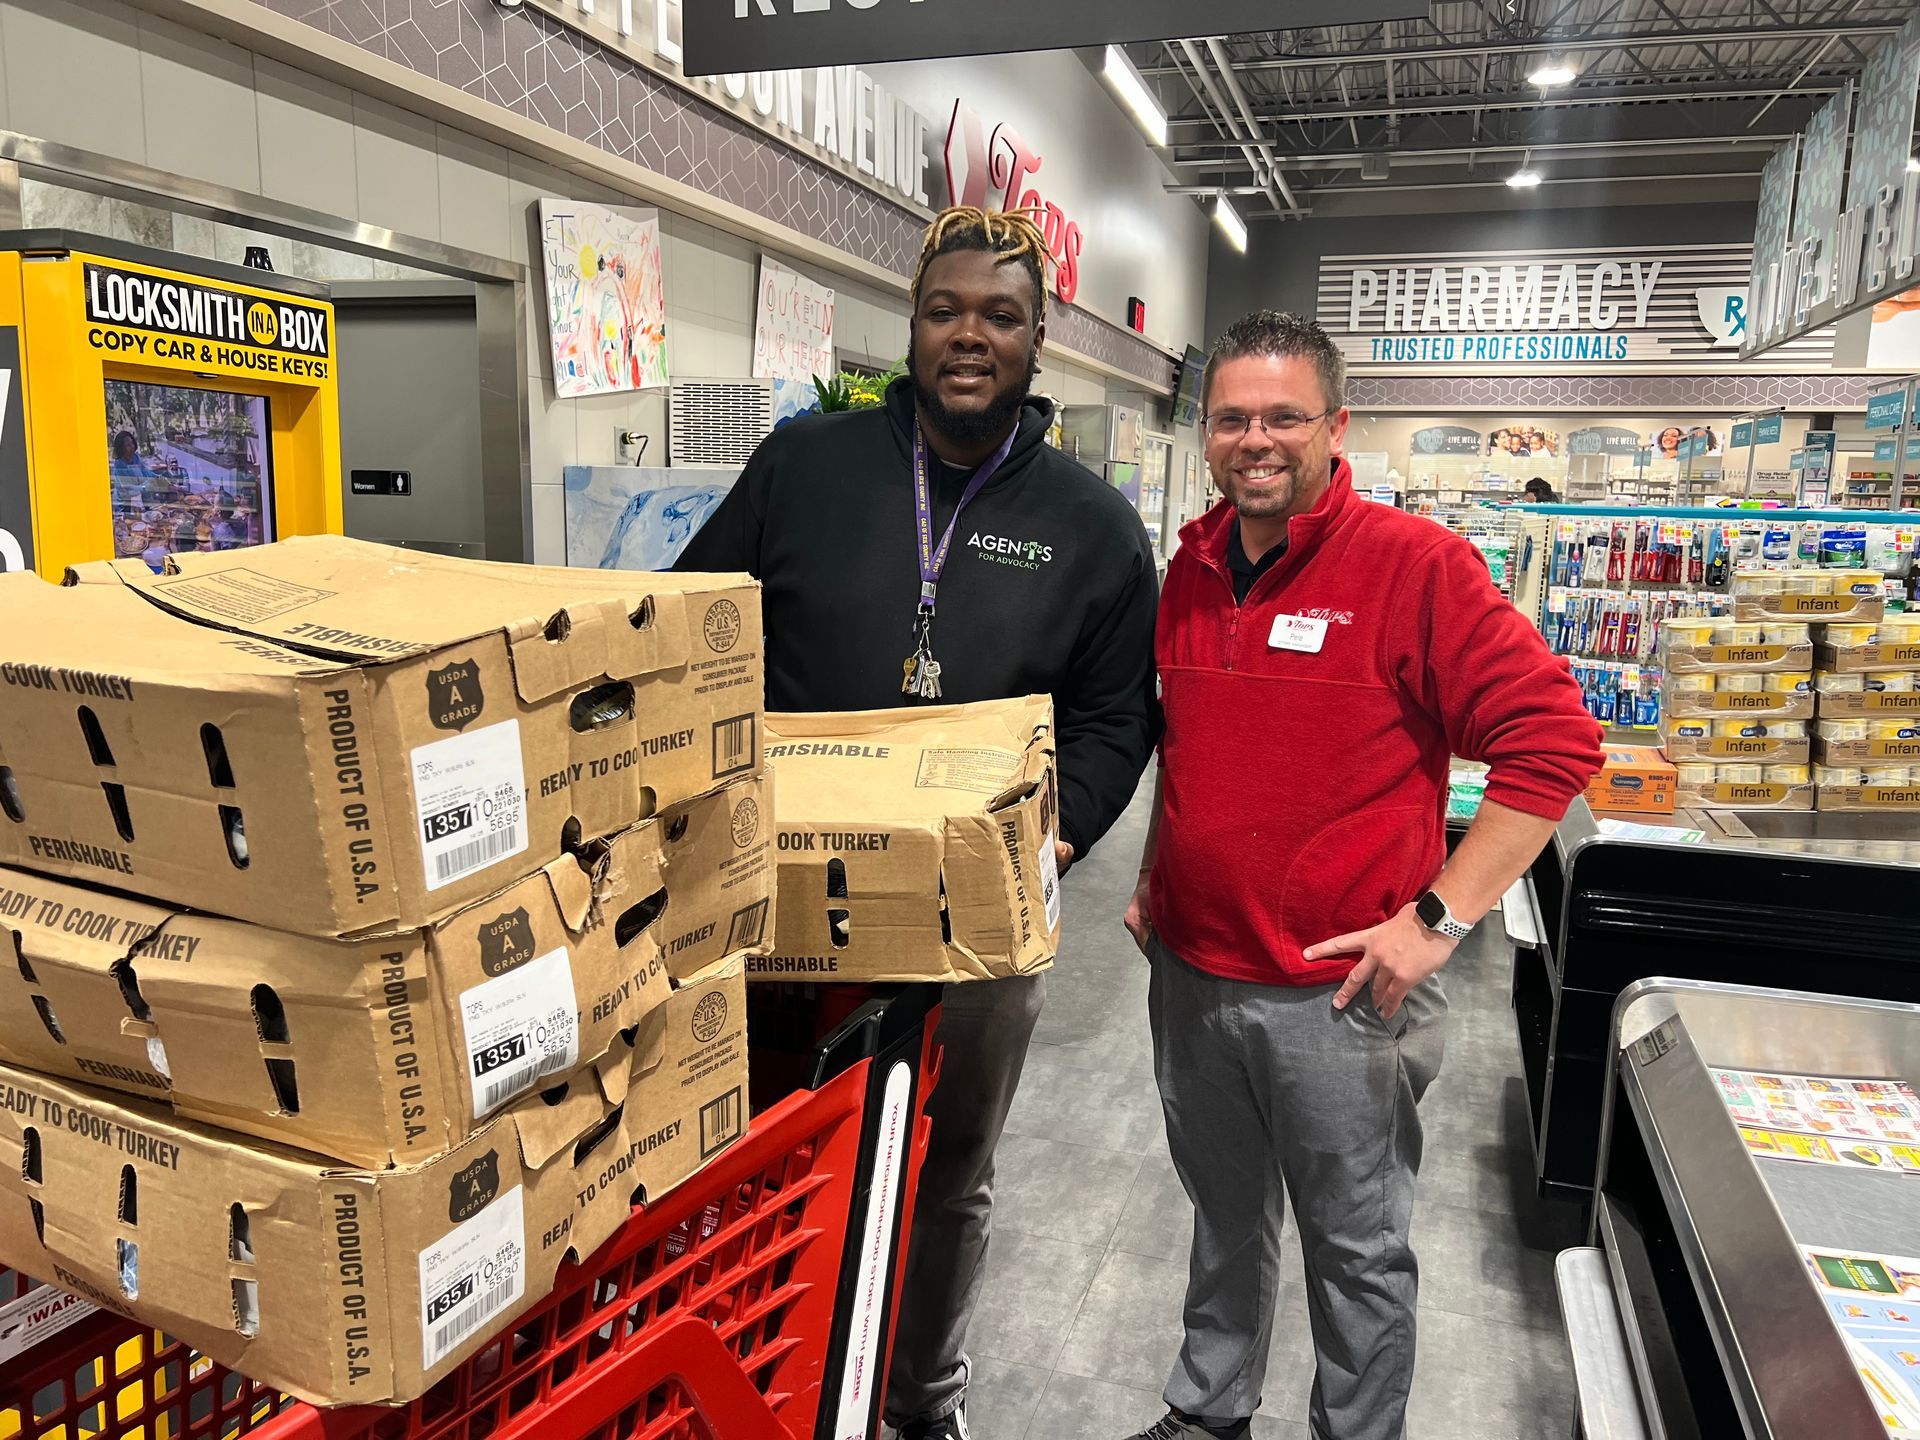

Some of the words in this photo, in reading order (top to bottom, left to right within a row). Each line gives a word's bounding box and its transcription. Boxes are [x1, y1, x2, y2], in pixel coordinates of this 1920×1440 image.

[814, 65, 929, 206] AVENUE
[549, 250, 579, 286] YOUR
[1349, 261, 1662, 333] PHARMACY
[90, 270, 246, 341] LOCKSMITH
[251, 310, 265, 334] IN
[266, 312, 275, 336] A
[279, 306, 327, 354] BOX
[813, 300, 834, 335] IN
[88, 328, 148, 354] COPY
[154, 338, 196, 361] CAR
[200, 345, 213, 363] &
[218, 348, 278, 372] HOUSE
[283, 357, 329, 379] KEYS!
[757, 326, 786, 364] OUR
[1372, 336, 1456, 361] TRUSTED
[1463, 335, 1627, 361] PROFESSIONALS
[1448, 436, 1461, 444] LIVE
[1462, 436, 1477, 444] WELL
[1606, 437, 1619, 445] LIVE
[1620, 437, 1636, 445] WELL
[354, 482, 375, 490] Women
[978, 552, 995, 562] FOR
[996, 555, 1040, 571] ADVOCACY
[705, 601, 739, 627] INSPECTED
[1797, 599, 1840, 610] Infant
[716, 616, 730, 630] U.S.
[1728, 649, 1768, 660] Infant
[0, 662, 57, 691] COOK
[57, 668, 134, 701] TURKEY
[438, 669, 469, 685] USDA
[694, 686, 709, 695] PRIOR
[709, 684, 716, 692] TO
[716, 680, 733, 692] DISPLAY
[733, 678, 742, 687] AND
[743, 675, 754, 685] SALE
[450, 685, 463, 705] A
[1729, 695, 1770, 707] Infant
[440, 704, 478, 724] GRADE
[324, 689, 364, 795] PRODUCT
[589, 757, 608, 778] TO
[613, 747, 638, 771] COO
[641, 728, 694, 757] TURKEY
[764, 743, 891, 759] ERISHABLE
[1726, 741, 1767, 752] Infant
[417, 762, 434, 775] TOPS
[728, 758, 738, 768] 04
[493, 795, 521, 812] 221030
[494, 786, 514, 799] 9468
[1731, 787, 1771, 797] Infant
[343, 803, 370, 832] OF
[424, 805, 472, 841] 1357
[490, 810, 519, 832] 56.95
[777, 832, 816, 851] OOK
[820, 832, 891, 851] TURKEY
[29, 836, 134, 875] PERISHABLE
[349, 839, 379, 904] U.S.A.
[1017, 884, 1027, 904] OF
[35, 900, 64, 927] TO
[63, 907, 120, 942] COOK
[490, 917, 520, 936] USDA
[1018, 907, 1033, 948] U.S.A.
[503, 934, 515, 954] A
[493, 948, 530, 972] GRADE
[593, 981, 630, 1024] READY
[633, 969, 646, 991] TO
[670, 921, 717, 955] TURKEY
[380, 952, 415, 1046] PRODUCT
[466, 1001, 483, 1014] TOPS
[694, 993, 725, 1021] INSPECTED
[547, 1010, 566, 1025] 9468
[704, 1006, 716, 1022] U.S.
[545, 1017, 574, 1038] 221030
[474, 1033, 525, 1076] 1357
[543, 1033, 572, 1057] 56.53
[678, 1057, 687, 1069] NET
[717, 1034, 735, 1049] MARKED
[394, 1052, 419, 1079] OF
[680, 1075, 695, 1088] PRIOR
[695, 1072, 701, 1081] TO
[701, 1063, 719, 1078] DISPLAY
[719, 1059, 729, 1068] AND
[729, 1051, 740, 1063] SALE
[689, 1056, 714, 1073] CONSUMER
[713, 1045, 733, 1061] PACKAGE
[400, 1084, 427, 1146] U.S.A.
[888, 1102, 900, 1143] YOUR
[42, 1098, 62, 1127] TO
[68, 1109, 112, 1146] COOK
[116, 1126, 180, 1170] TURKEY
[715, 1132, 726, 1144] 04
[461, 1160, 488, 1183] USDA
[576, 1183, 596, 1208] TO
[630, 1119, 682, 1159] TURKEY
[469, 1179, 481, 1198] A
[458, 1189, 493, 1217] GRADE
[873, 1145, 893, 1262] NEIGHBORHOOD
[334, 1193, 364, 1288] PRODUCT
[495, 1242, 515, 1259] 9468
[426, 1251, 442, 1266] TOPS
[493, 1247, 521, 1271] 221030
[488, 1261, 519, 1290] 55.30
[866, 1263, 877, 1312] STORE
[27, 1294, 81, 1327] !WAR
[342, 1294, 367, 1320] OF
[428, 1274, 473, 1321] 1357
[861, 1315, 871, 1352] WITH
[345, 1326, 370, 1386] U.S.A.
[854, 1354, 865, 1401] MORE
